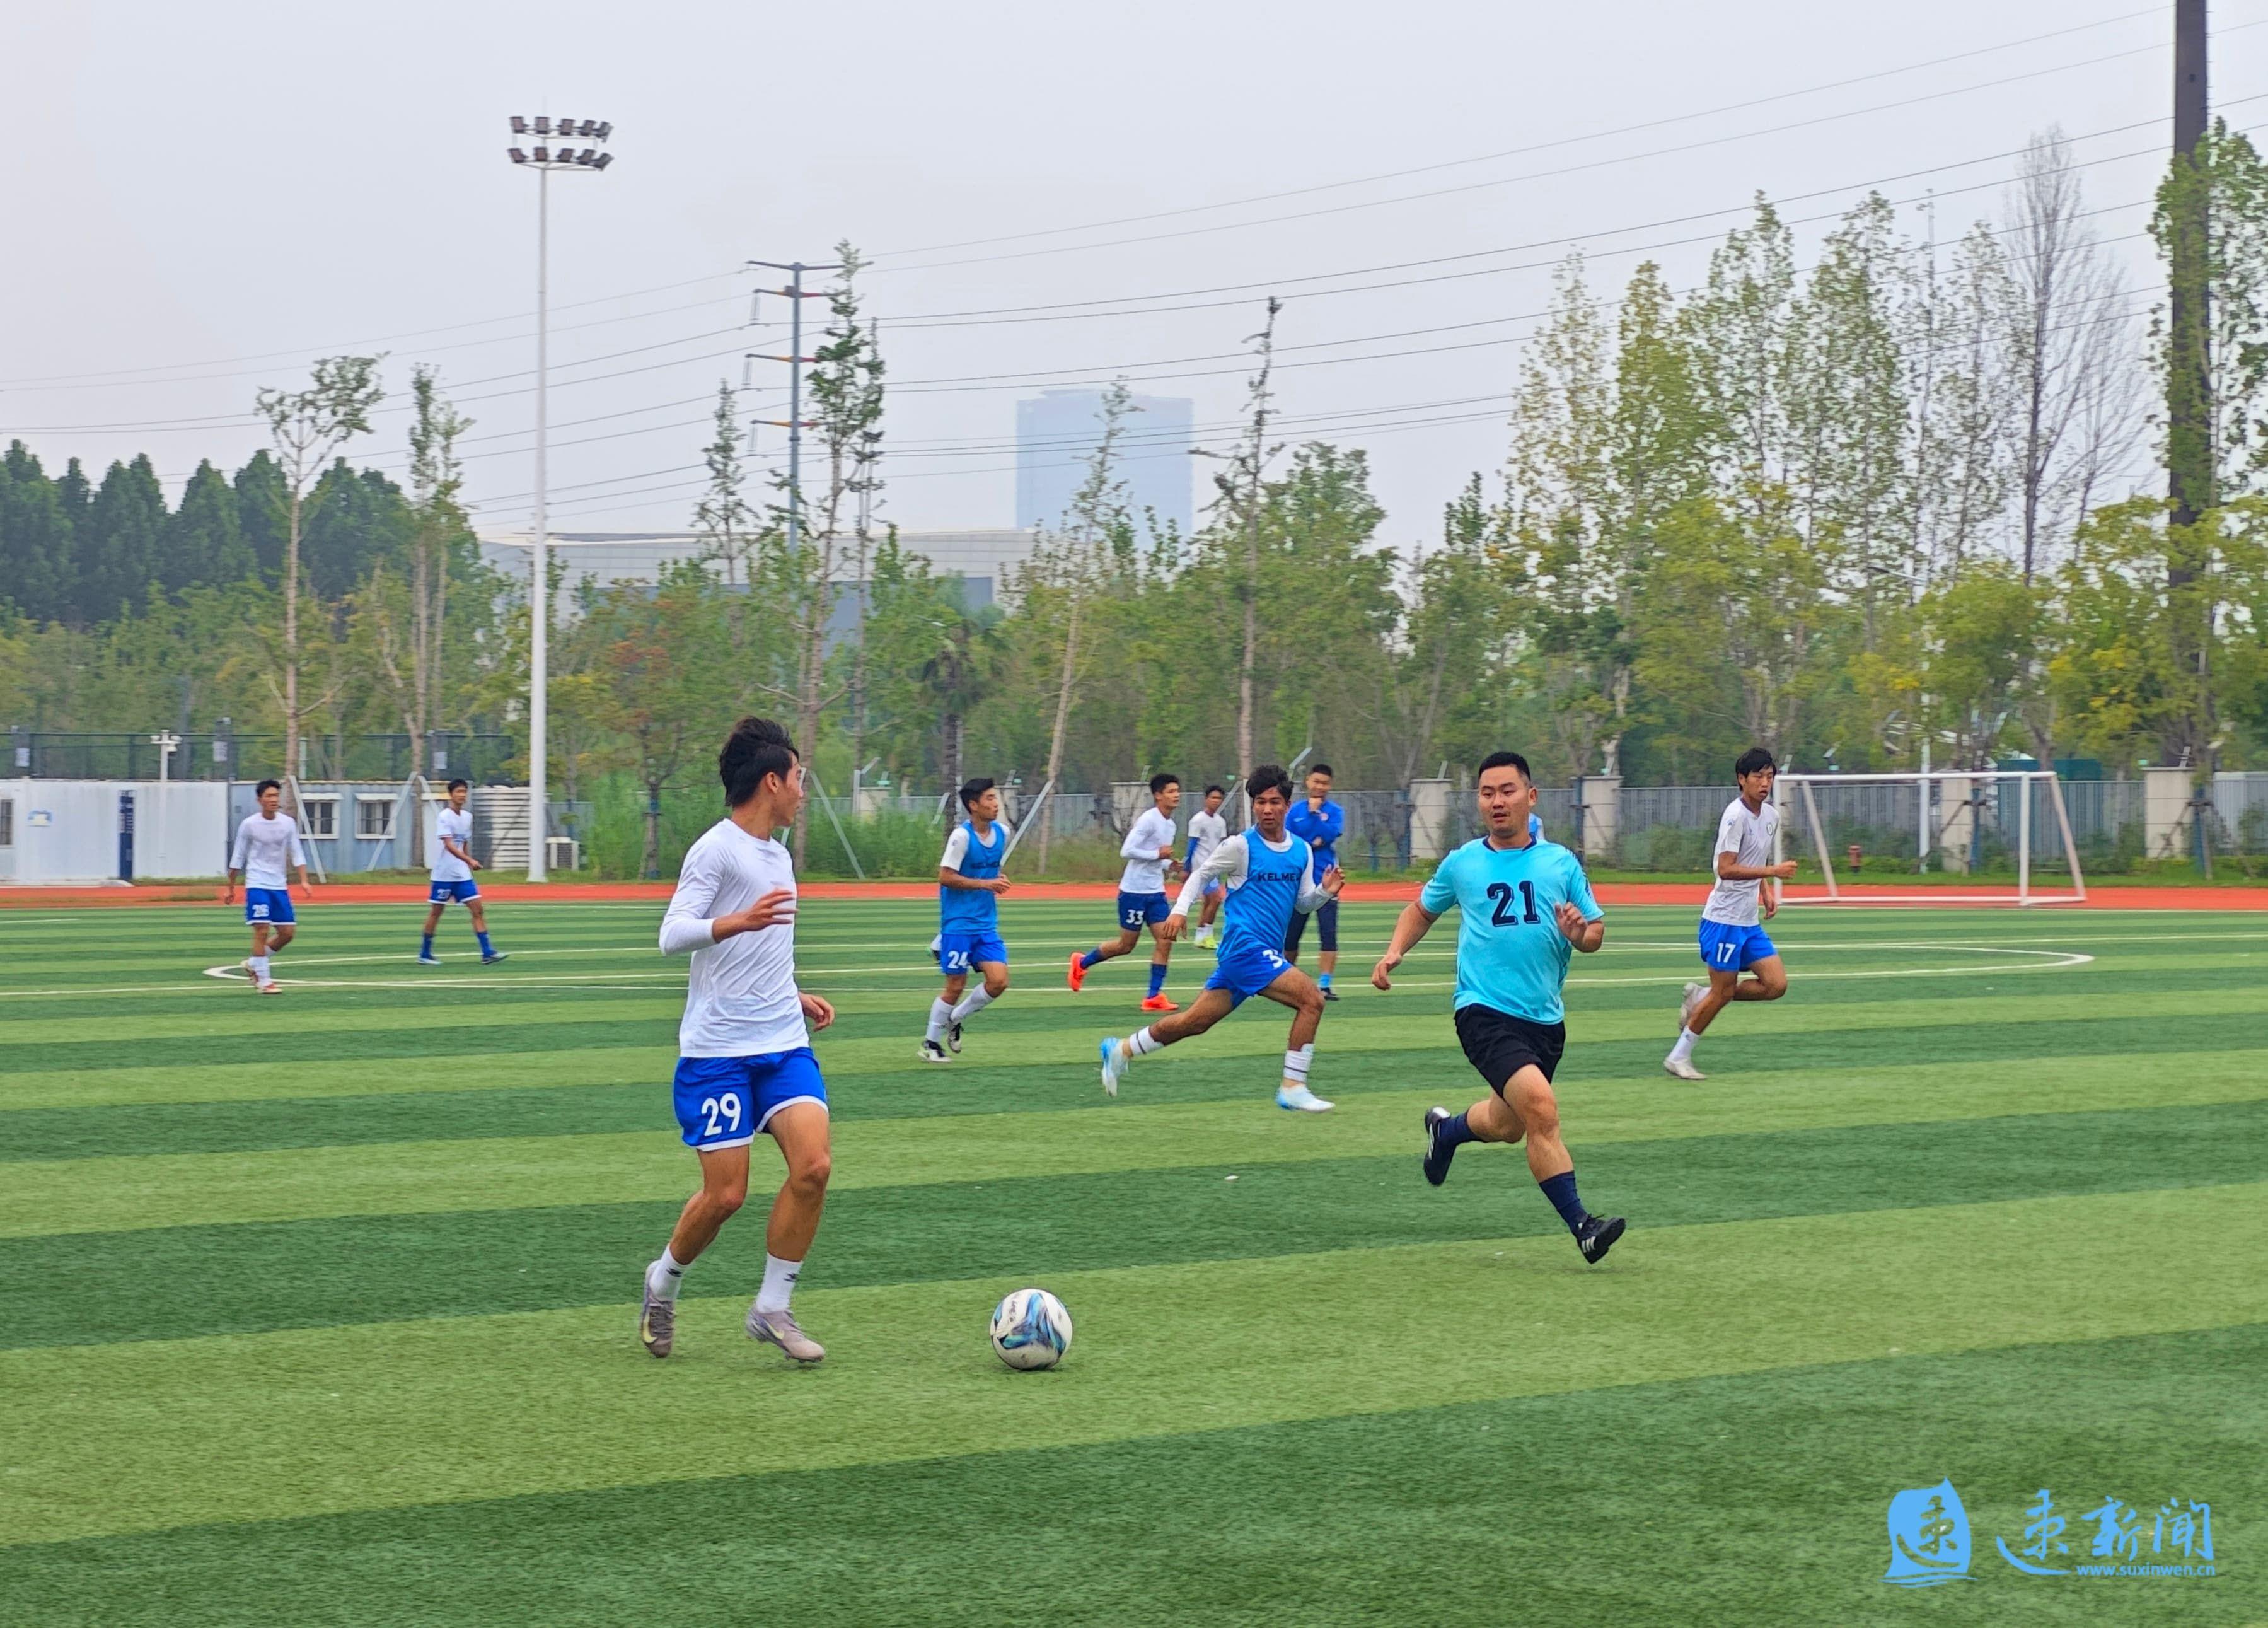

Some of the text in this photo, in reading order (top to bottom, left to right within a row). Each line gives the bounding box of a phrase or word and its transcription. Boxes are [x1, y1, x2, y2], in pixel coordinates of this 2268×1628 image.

[1258, 872, 1295, 882] KELME
[1486, 880, 1541, 927] 21
[1126, 909, 1145, 925] 33
[947, 950, 969, 969] 24
[1262, 949, 1283, 968] 3
[1716, 942, 1737, 963] 17
[701, 1092, 741, 1137] 29
